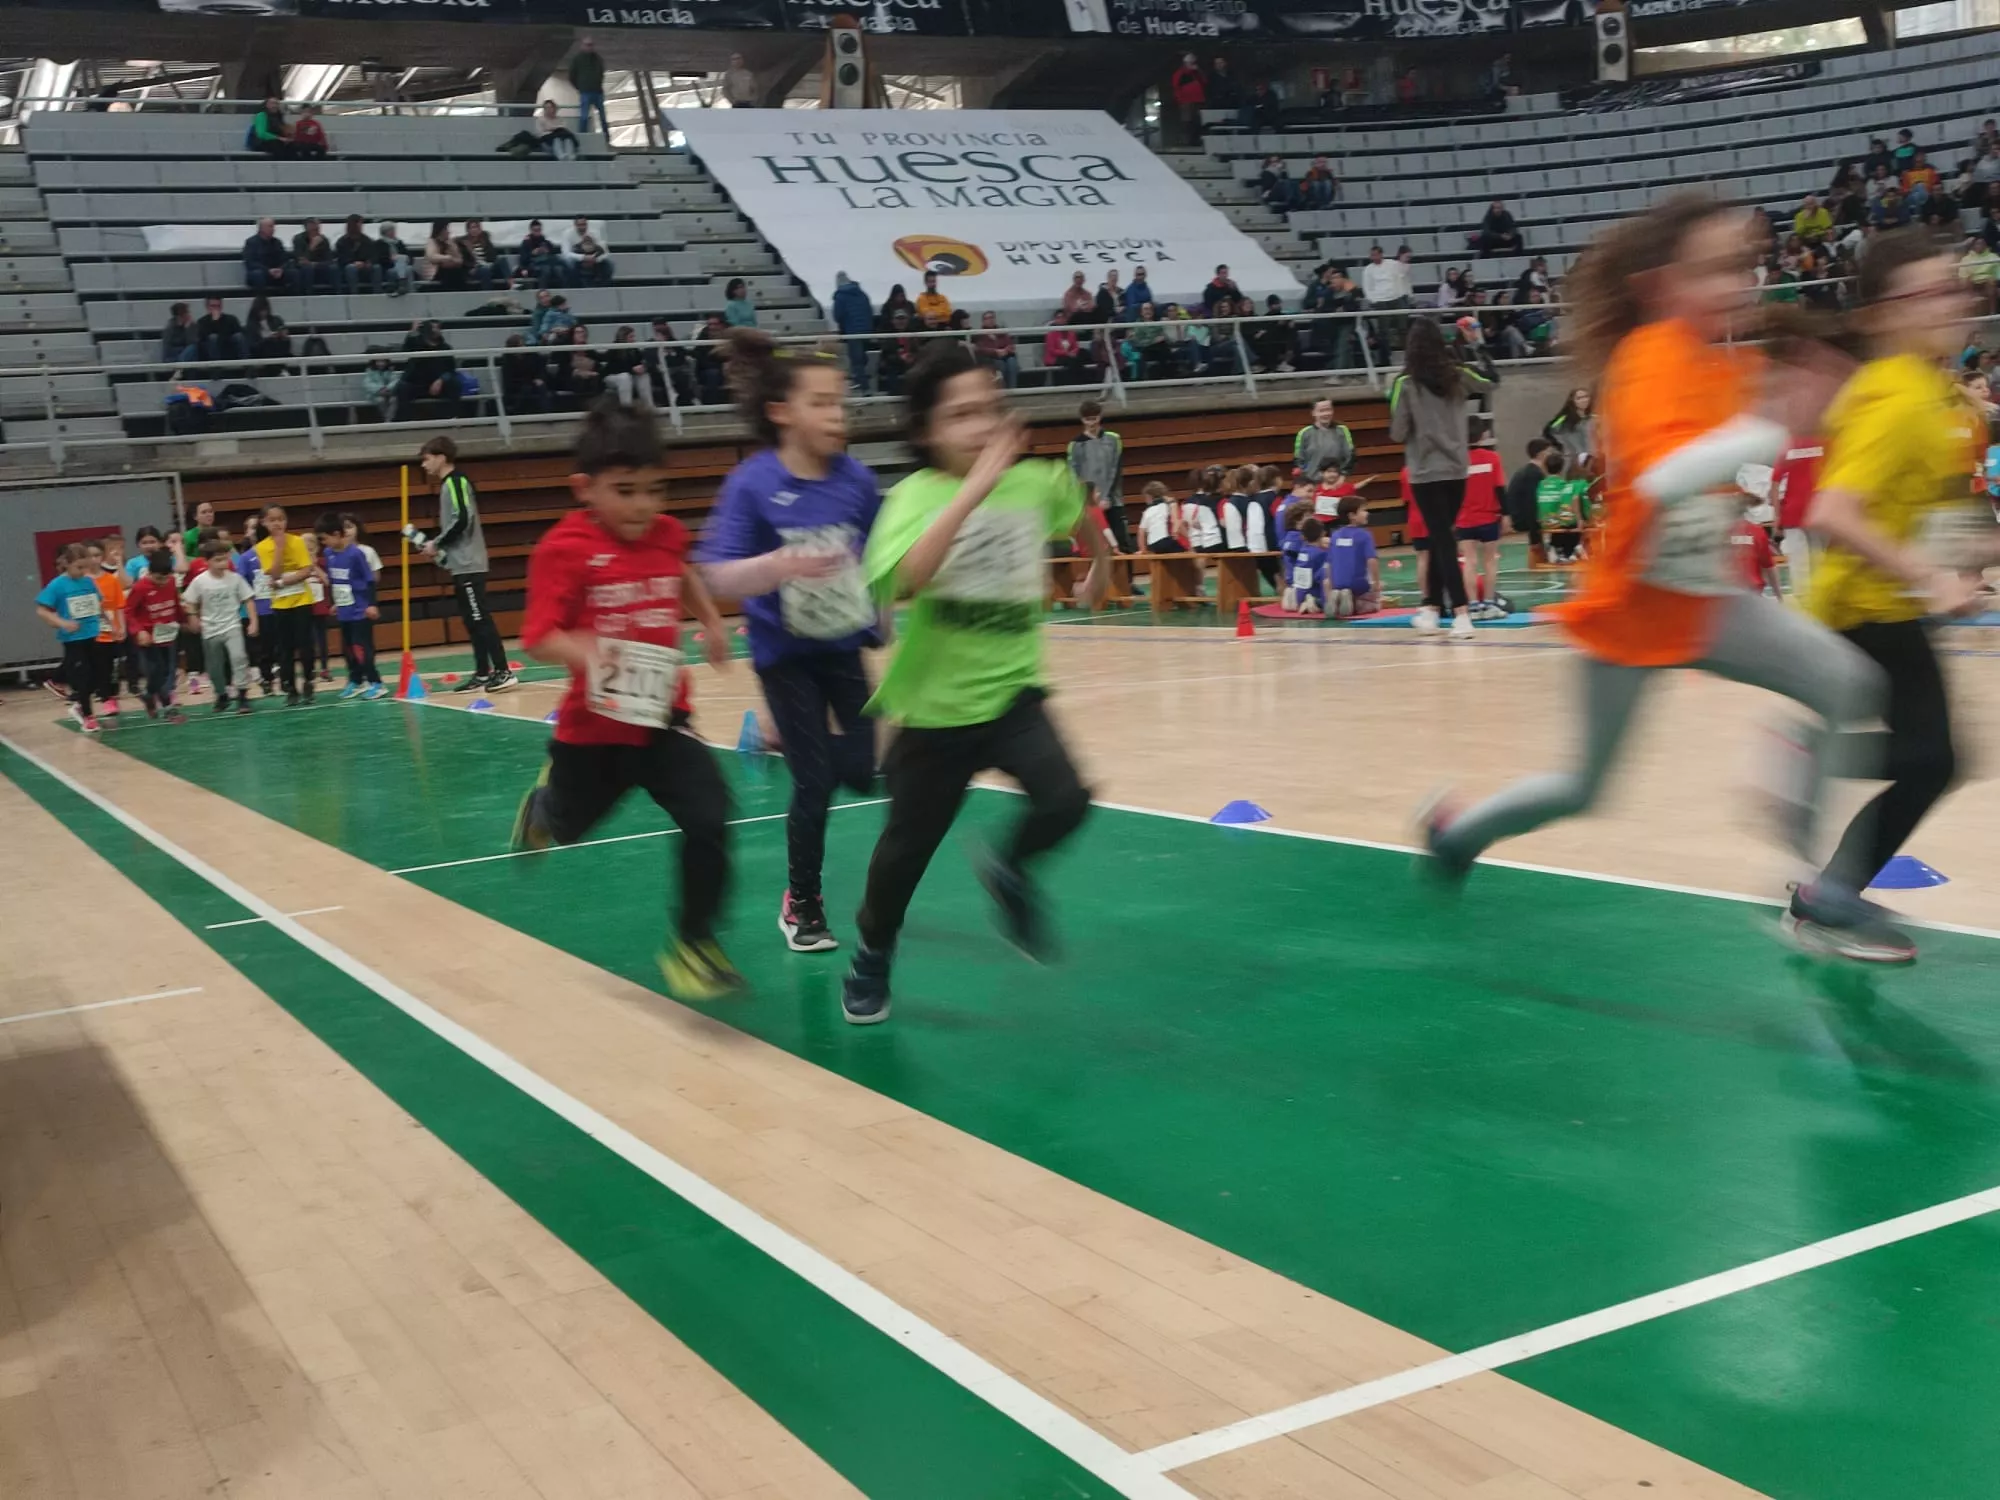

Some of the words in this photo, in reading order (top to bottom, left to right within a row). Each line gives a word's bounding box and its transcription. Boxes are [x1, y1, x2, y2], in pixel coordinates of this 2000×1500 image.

[1117, 16, 1142, 35] de
[1144, 16, 1220, 36] Huesca
[753, 150, 1136, 184] Huesca
[1006, 251, 1177, 265] HUESCA
